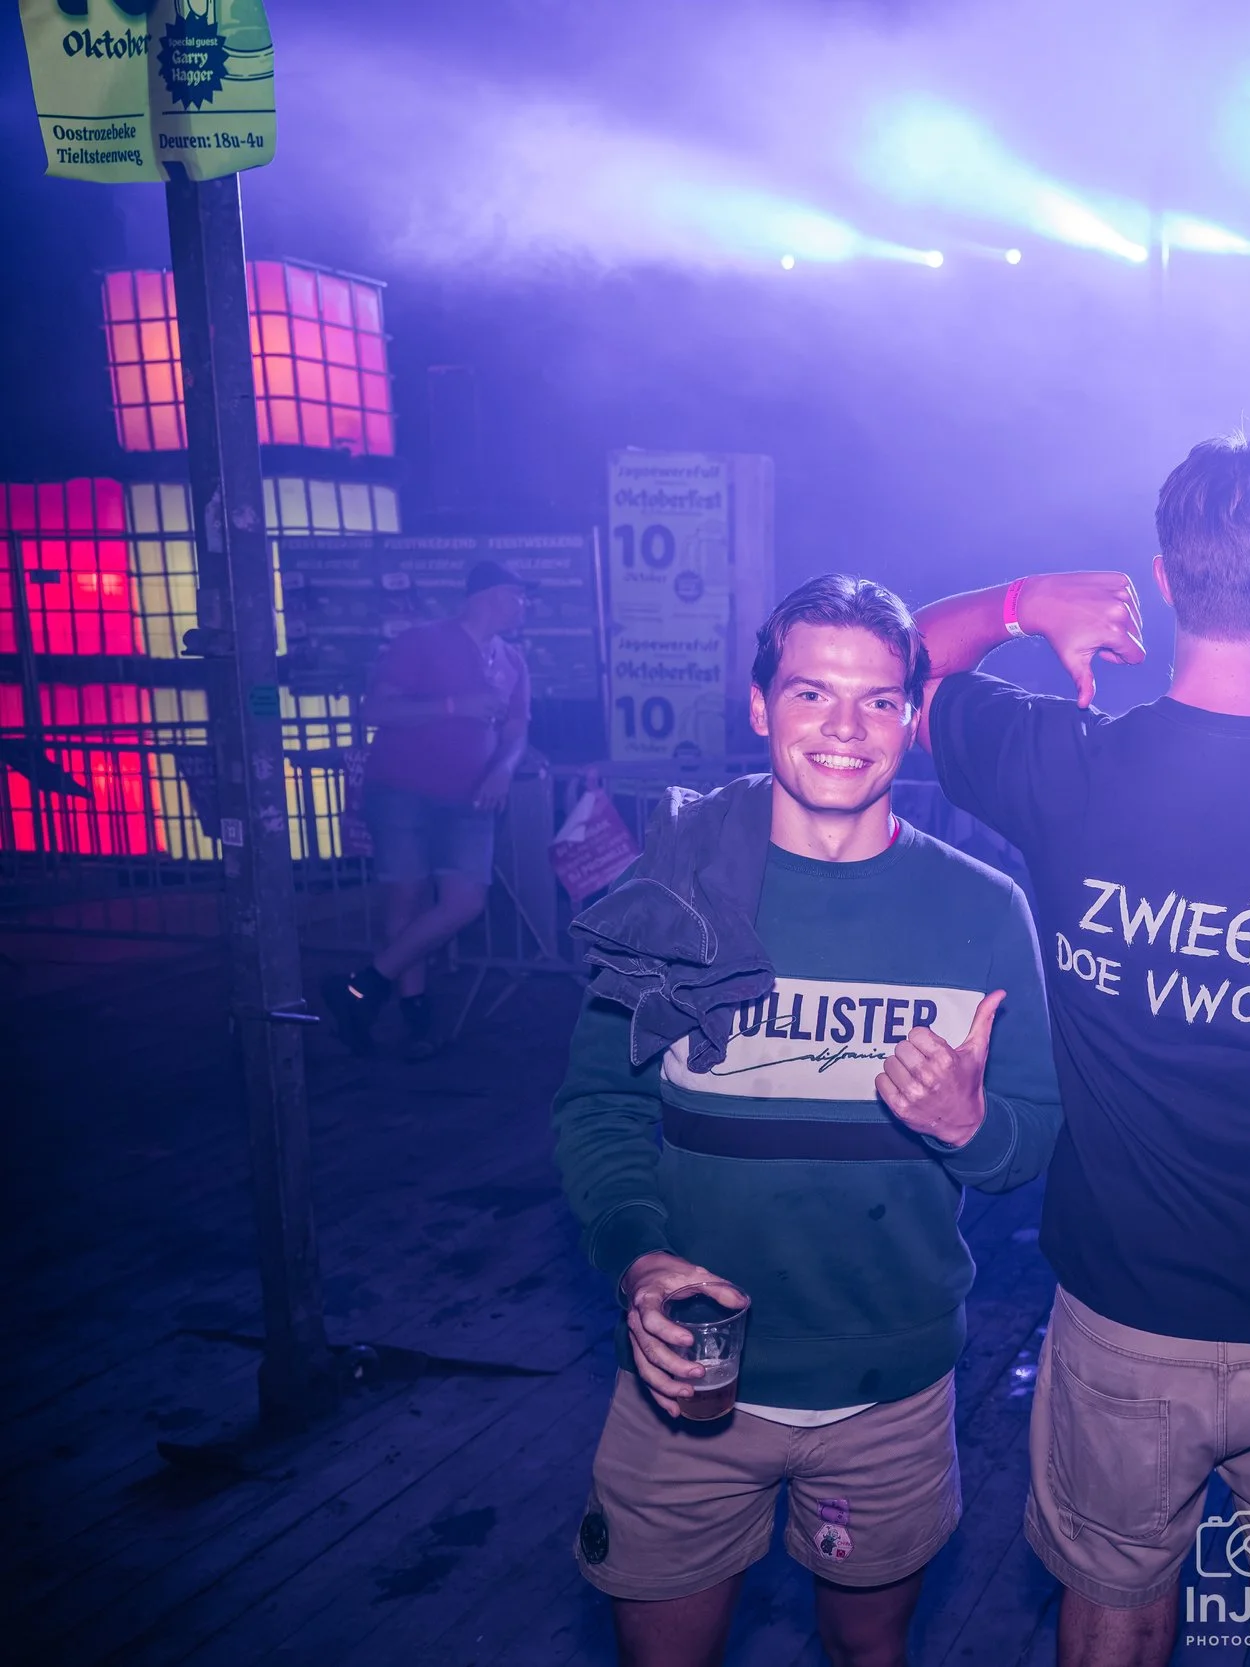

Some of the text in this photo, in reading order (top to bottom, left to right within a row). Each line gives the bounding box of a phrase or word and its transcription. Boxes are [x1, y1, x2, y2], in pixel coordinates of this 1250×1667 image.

[63, 28, 152, 59] Oktober
[196, 38, 218, 48] guest
[172, 50, 208, 68] Garry
[171, 68, 213, 86] Hagger
[53, 123, 136, 141] Oostrozebeke
[159, 132, 264, 149] Deuren: 18u-4u
[57, 147, 143, 166] Tieltsteenweg
[613, 523, 676, 571] 10
[615, 696, 675, 739] 10
[1056, 932, 1121, 996] DOE
